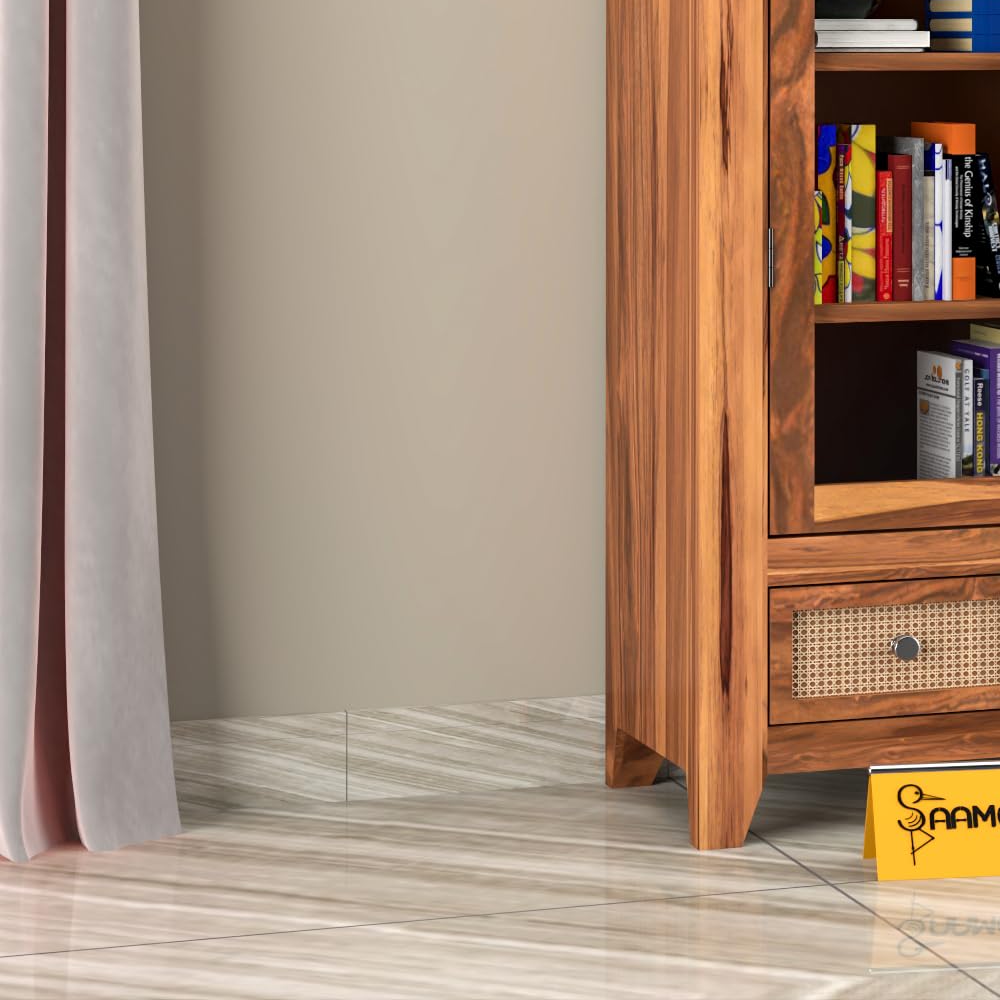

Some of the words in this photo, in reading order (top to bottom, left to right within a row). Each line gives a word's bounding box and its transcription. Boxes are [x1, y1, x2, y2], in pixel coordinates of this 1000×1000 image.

[963, 156, 974, 169] the
[964, 170, 974, 197] Genius
[964, 198, 974, 207] of
[962, 209, 974, 238] Kinship
[964, 396, 970, 407] AT
[976, 382, 984, 407] Reese
[976, 412, 984, 442] HONG
[976, 444, 984, 473] KONG
